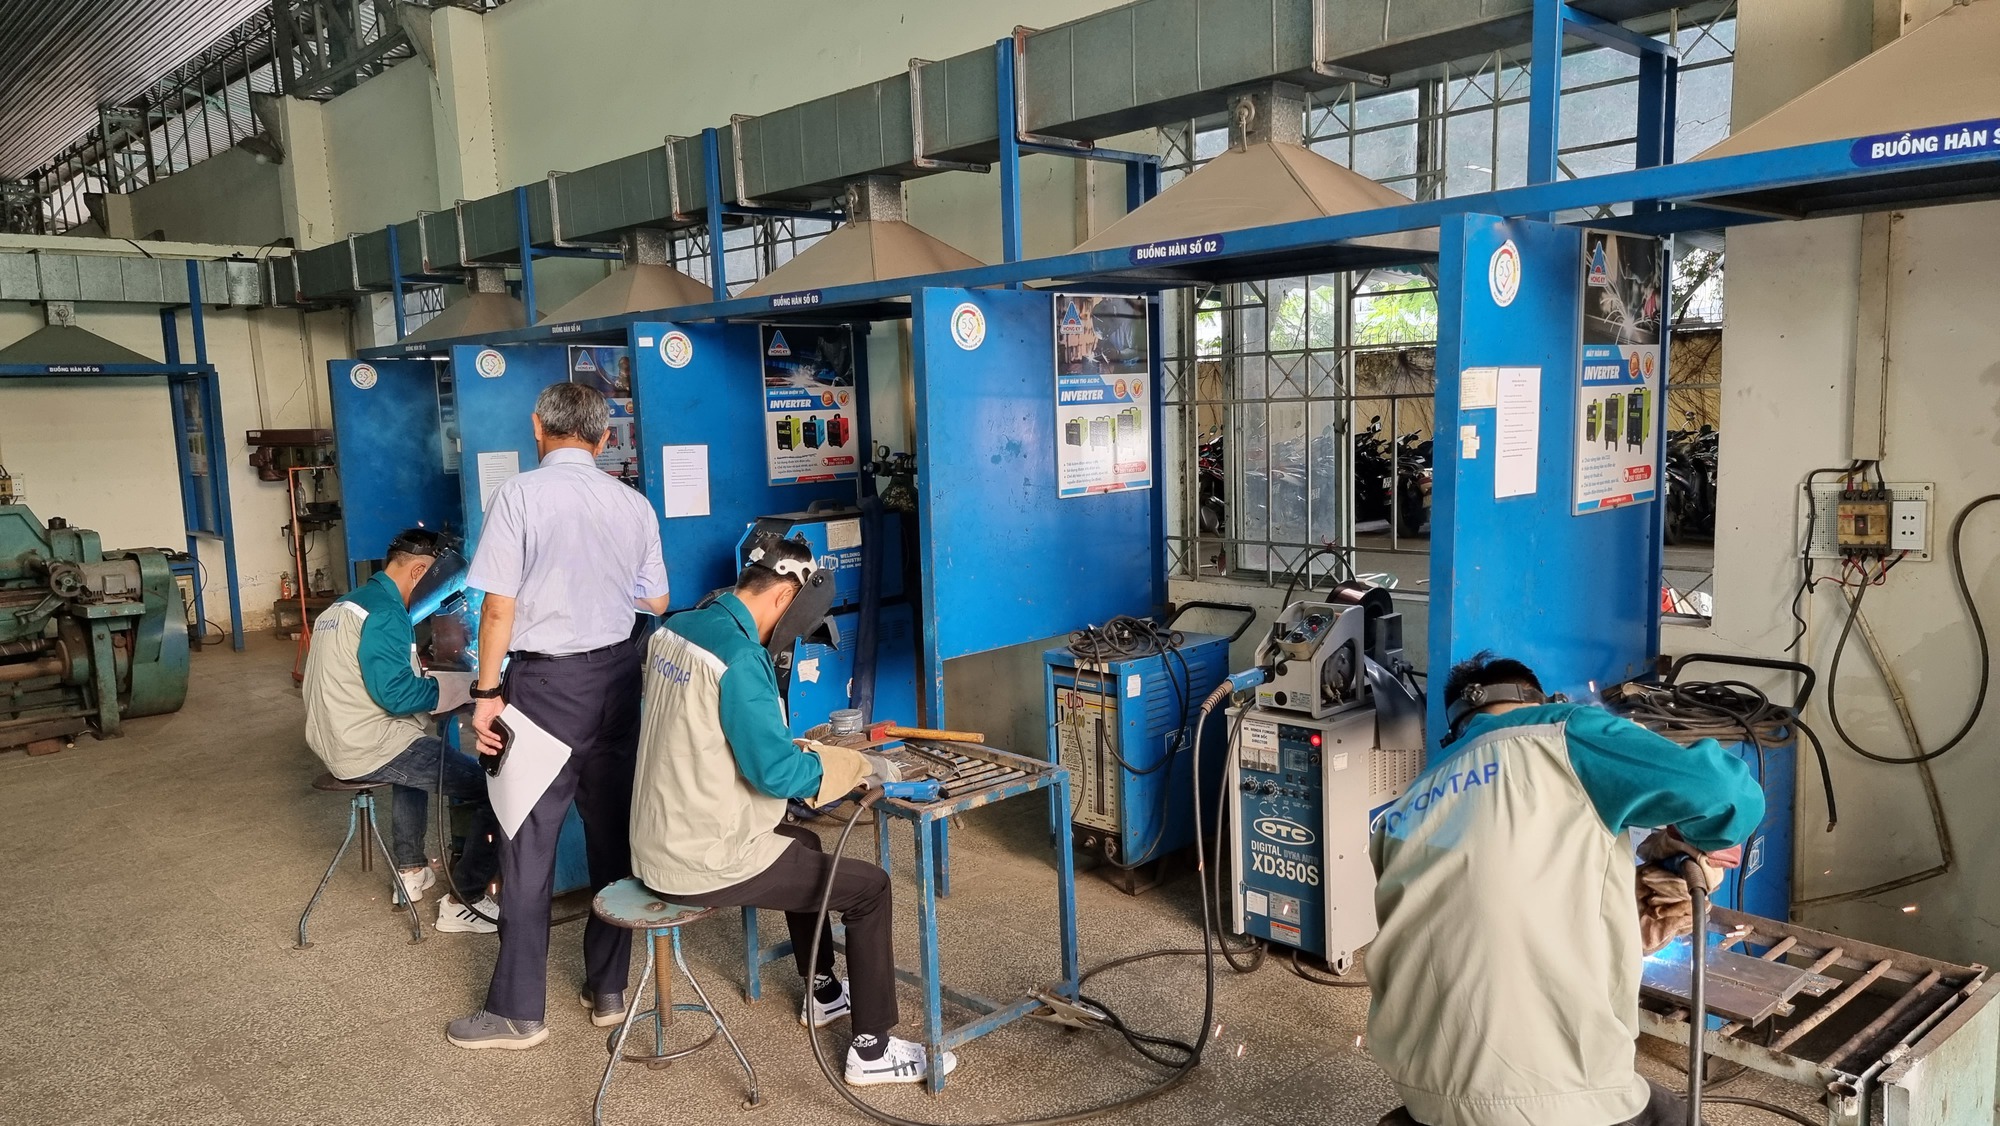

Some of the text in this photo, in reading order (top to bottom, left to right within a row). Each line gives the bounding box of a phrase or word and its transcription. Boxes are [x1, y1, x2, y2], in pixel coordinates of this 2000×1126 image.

[1871, 133, 1938, 159] BUỒNG
[1944, 128, 1987, 150] HÀN
[1137, 238, 1217, 259] BUỒNG HÀN SỐ 02
[773, 293, 818, 307] BUỒNG HÀN SỐ 03
[1584, 365, 1620, 380] INVERTER
[770, 399, 812, 409] INVERTER
[1061, 390, 1103, 402] INVERTER
[1261, 822, 1306, 841] OTC
[1251, 840, 1318, 865] DIGITAL DYNA AUTO
[1252, 852, 1319, 886] XD350S
[852, 1038, 878, 1048] adidas
